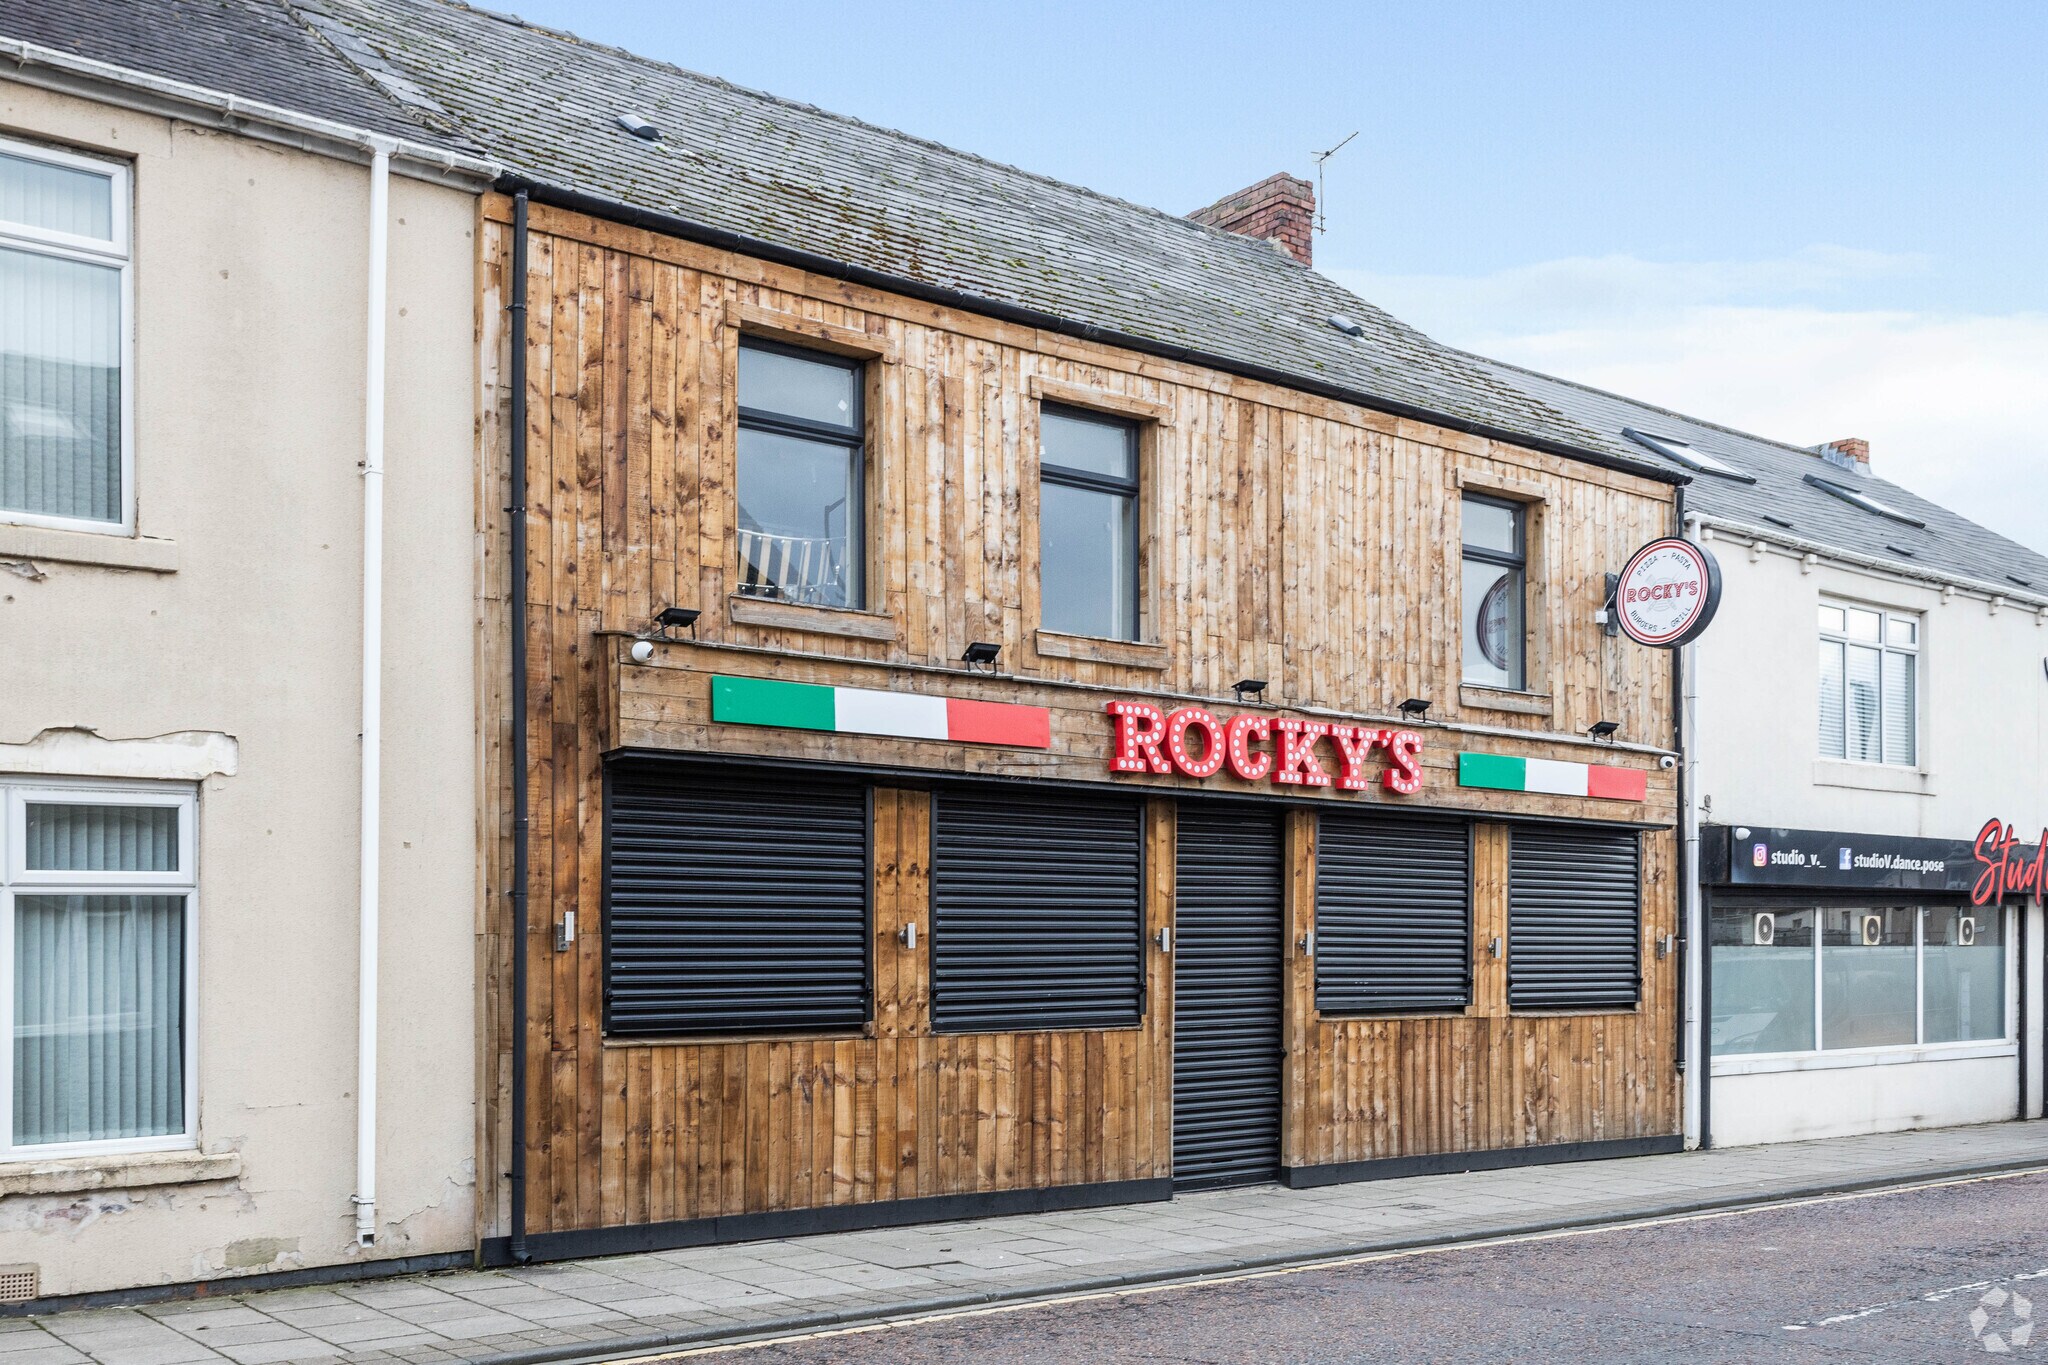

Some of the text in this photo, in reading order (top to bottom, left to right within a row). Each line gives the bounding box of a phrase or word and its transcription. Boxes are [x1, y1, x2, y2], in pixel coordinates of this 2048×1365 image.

[1636, 555, 1658, 576] PIZZA
[1671, 552, 1692, 570] PASTA
[1626, 580, 1698, 603] ROCKY'S
[1630, 610, 1658, 632] BURGERS
[1670, 607, 1692, 628] GRILL
[1107, 700, 1424, 795] ROCKY'S
[1771, 849, 1826, 868] studio_v._
[1854, 852, 1944, 874] studioV.dance.pose
[1971, 817, 2048, 907] Stud
